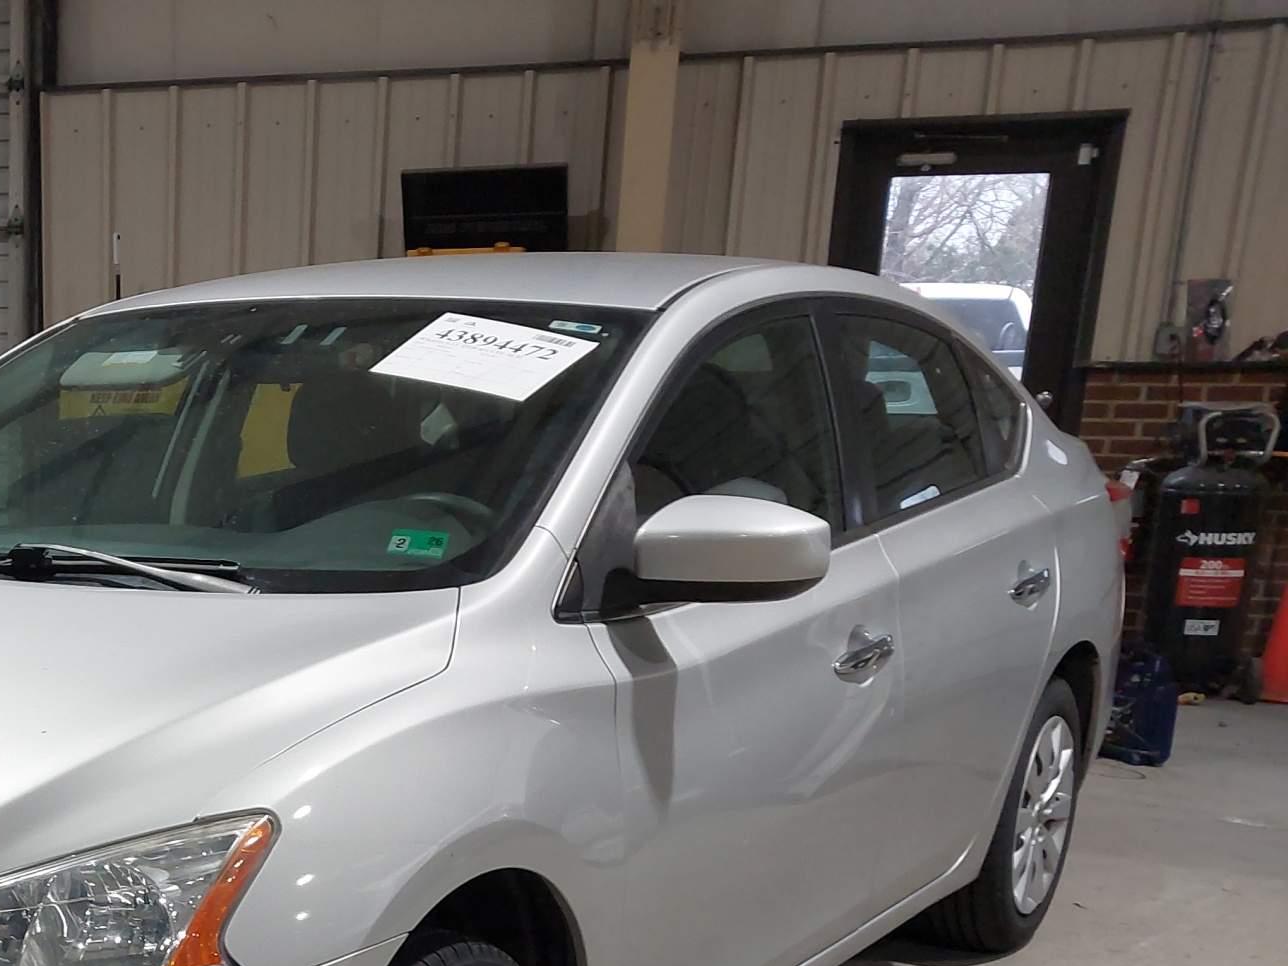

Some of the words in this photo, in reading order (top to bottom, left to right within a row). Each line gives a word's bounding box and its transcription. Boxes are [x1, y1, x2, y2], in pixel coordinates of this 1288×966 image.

[435, 328, 559, 361] 43894472
[395, 538, 407, 549] 2
[1198, 532, 1256, 545] HUSKY
[1200, 560, 1223, 570] 200
